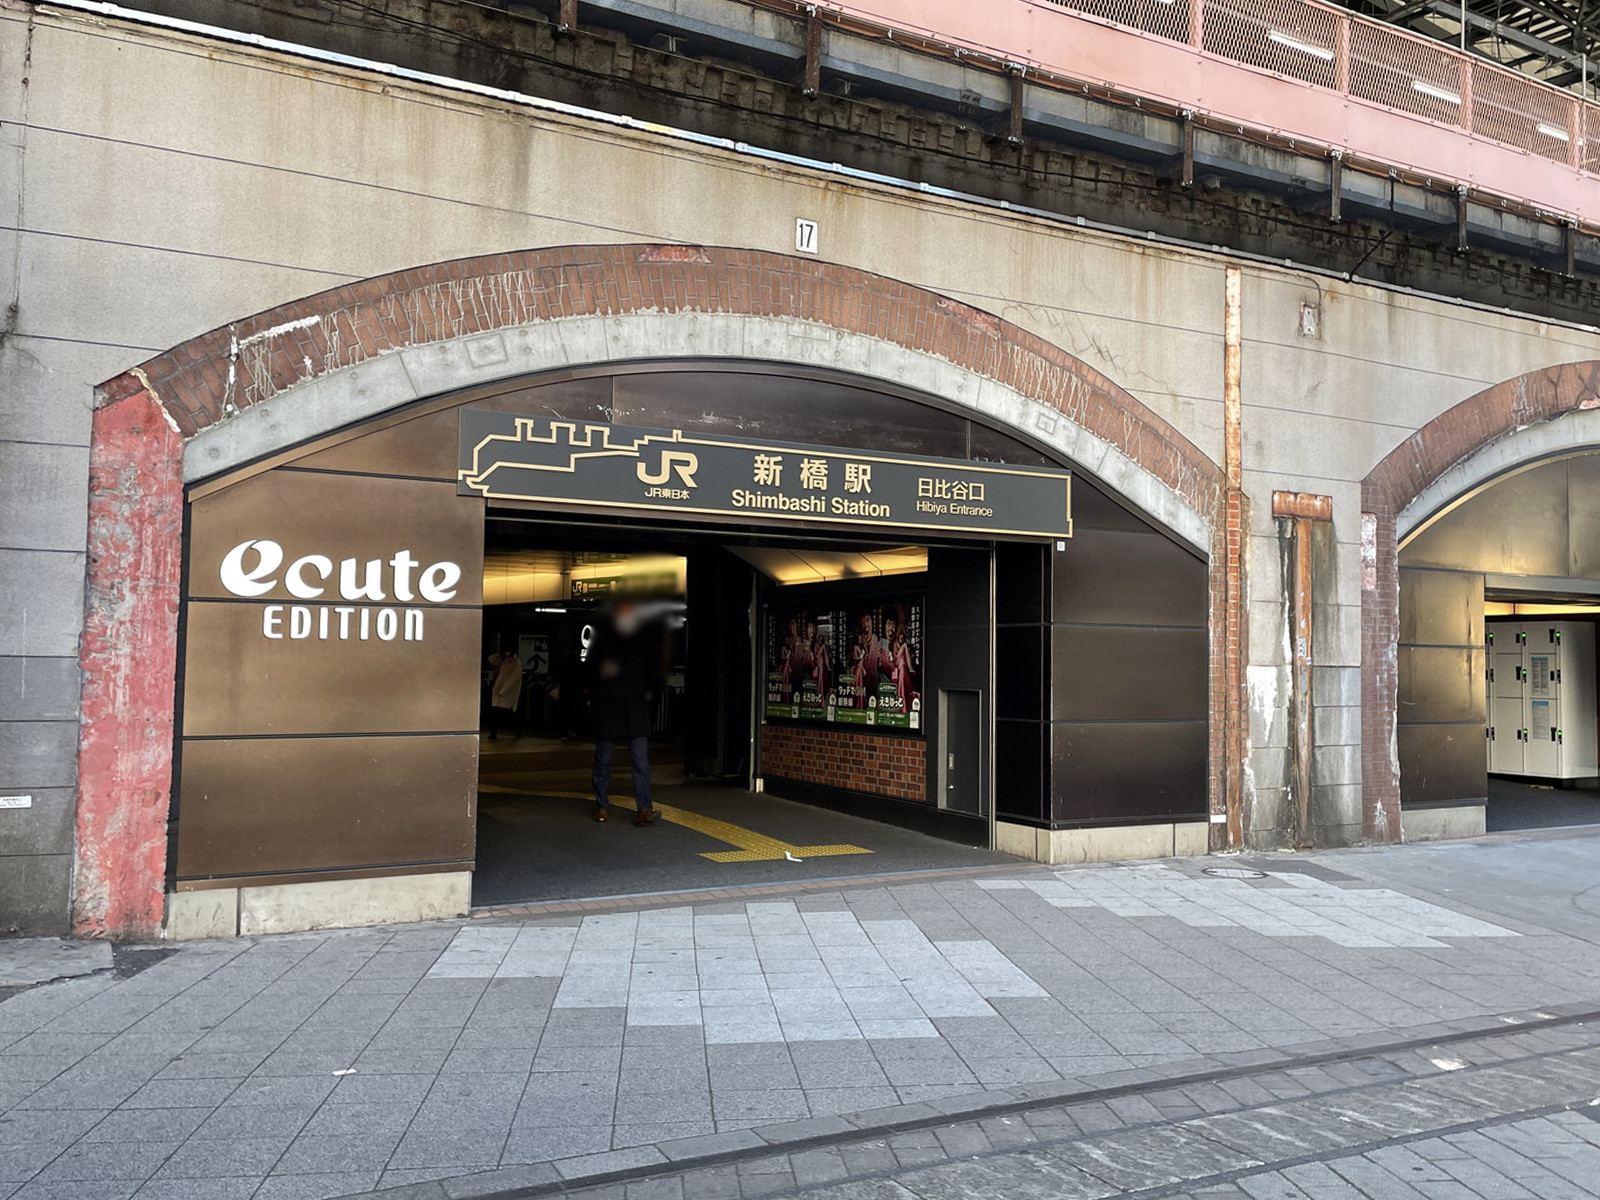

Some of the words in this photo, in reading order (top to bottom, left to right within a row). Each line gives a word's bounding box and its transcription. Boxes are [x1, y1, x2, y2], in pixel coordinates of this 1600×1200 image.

[799, 222, 814, 248] 17
[636, 450, 699, 488] JR
[753, 453, 873, 495] 新橋駅
[644, 486, 690, 500] JR東日本
[731, 488, 826, 514] Shimbashi
[831, 496, 891, 518] Station
[918, 477, 985, 502] 日比谷口
[916, 500, 948, 516] Hibiya
[949, 502, 993, 517] Entrance
[219, 539, 462, 603] ecute
[263, 605, 424, 641] EDITION
